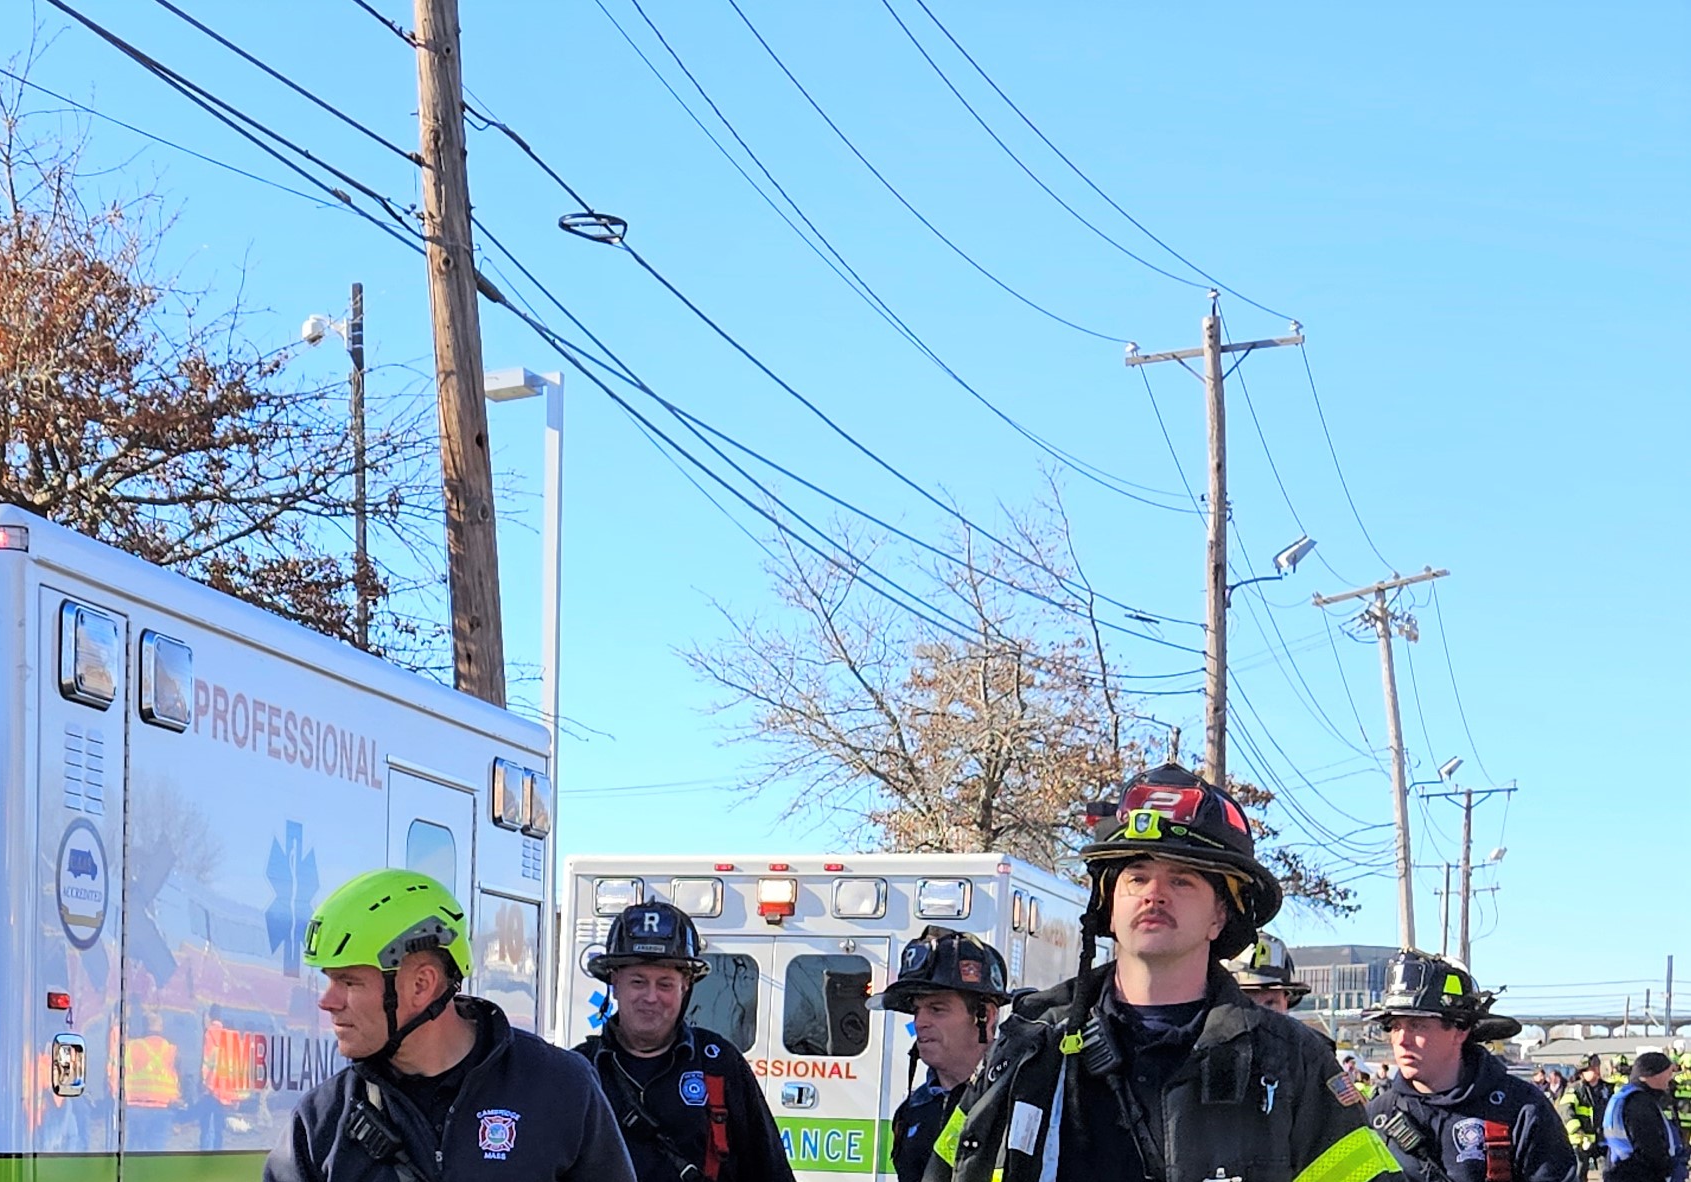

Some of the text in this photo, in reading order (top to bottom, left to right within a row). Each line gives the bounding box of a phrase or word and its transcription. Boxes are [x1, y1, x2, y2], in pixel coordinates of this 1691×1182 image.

[193, 678, 383, 790] PROFESSIONAL
[1143, 791, 1183, 818] 2
[643, 912, 660, 932] R
[65, 1007, 74, 1029] 4
[214, 1031, 340, 1091] AMBULANC
[750, 1059, 857, 1079] SSIONAL
[484, 1152, 506, 1160] MASS
